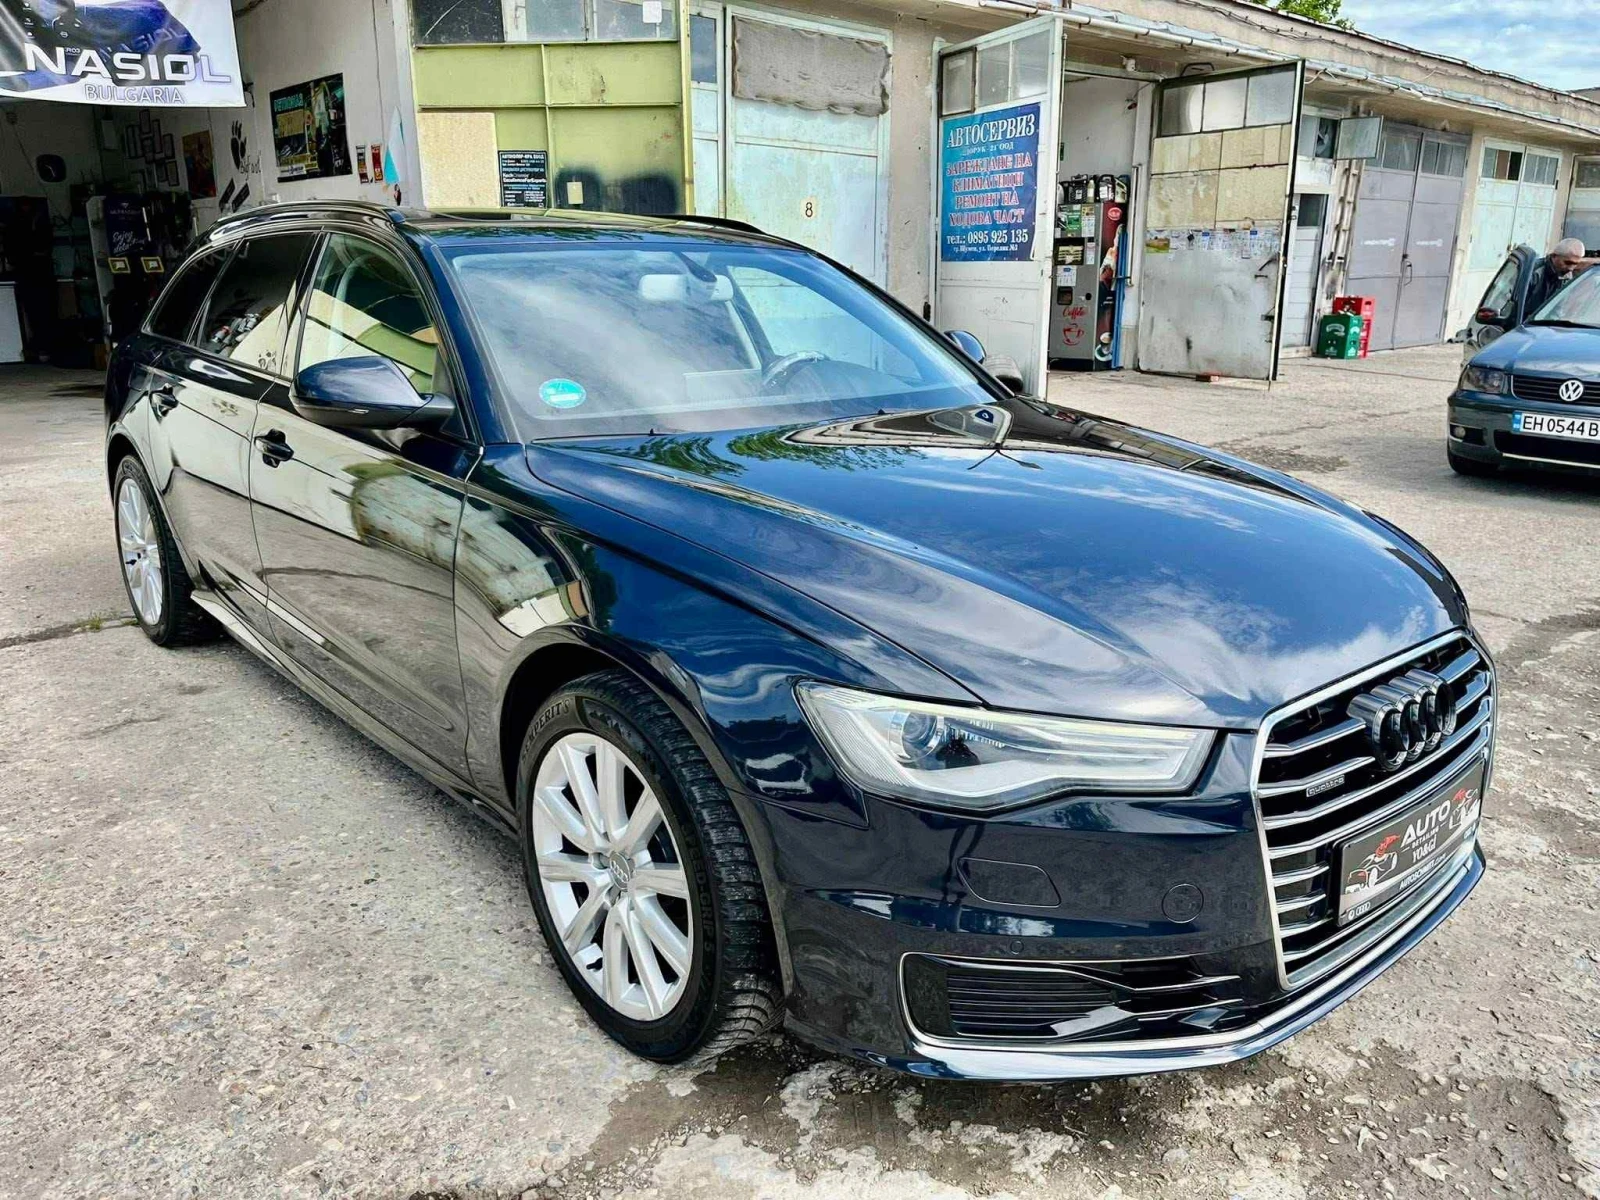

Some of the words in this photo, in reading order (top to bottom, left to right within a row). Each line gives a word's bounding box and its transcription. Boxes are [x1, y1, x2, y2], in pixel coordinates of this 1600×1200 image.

[24, 42, 232, 84] NASIOL
[85, 84, 185, 104] BULGARIA
[946, 113, 1035, 148] АВТОСЕРВИЗ
[999, 141, 1014, 151] ООД
[946, 154, 1013, 176] ЗАРЕЖДАНЕ
[1013, 152, 1033, 168] НА
[952, 171, 1025, 192] КЛИМАТИЦИ
[805, 201, 813, 218] 8
[955, 192, 1001, 209] РЕМОНТ
[1001, 189, 1019, 206] НА
[949, 210, 992, 229] ХОДОВА
[993, 208, 1025, 225] ЧАСТ
[946, 234, 966, 244] тел.:
[967, 230, 989, 244] 0895
[991, 229, 1008, 243] 925
[1010, 228, 1029, 243] 135
[1523, 415, 1545, 432] EH
[1547, 418, 1586, 436] 0544
[1588, 422, 1599, 437] B
[1308, 777, 1345, 796] quattro
[1400, 799, 1451, 848] AUTO
